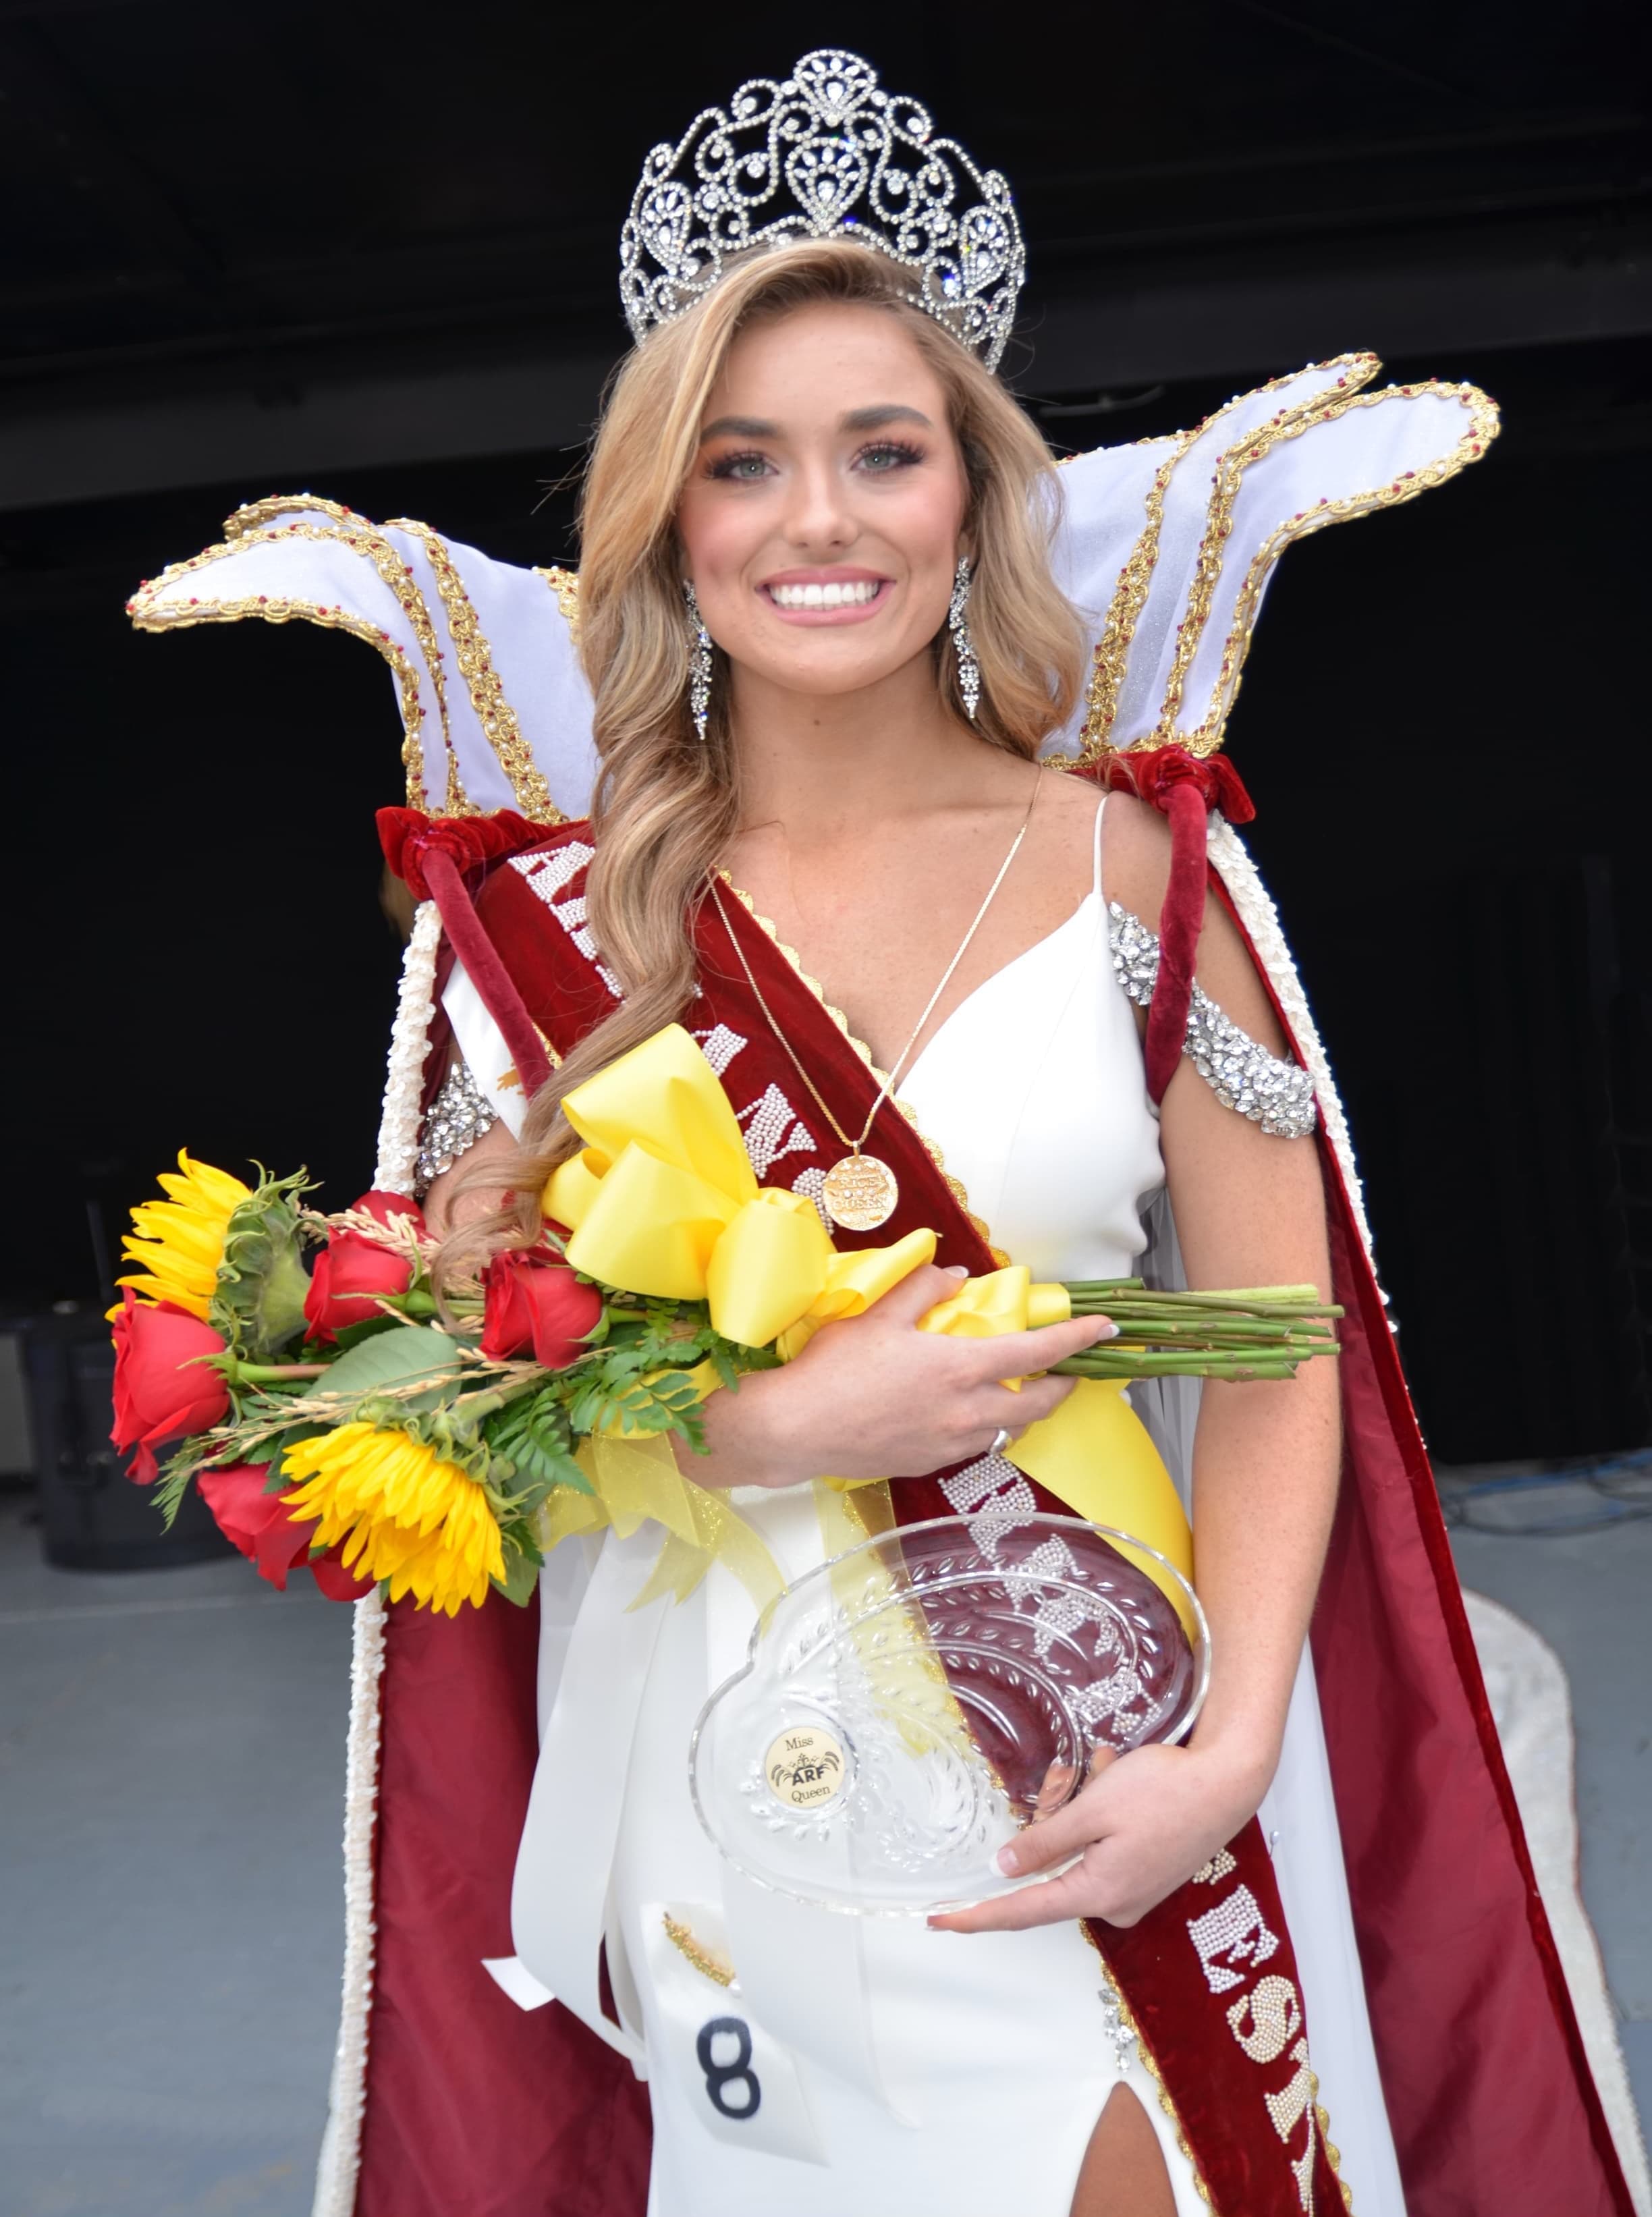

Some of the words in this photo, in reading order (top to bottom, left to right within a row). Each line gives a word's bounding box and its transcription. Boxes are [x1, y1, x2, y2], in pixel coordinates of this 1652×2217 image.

[937, 1451, 1162, 1753] RICE
[786, 1737, 814, 1751] Miss
[792, 1766, 825, 1786] ARF
[792, 1786, 831, 1803] Queen
[696, 2016, 761, 2120] 8
